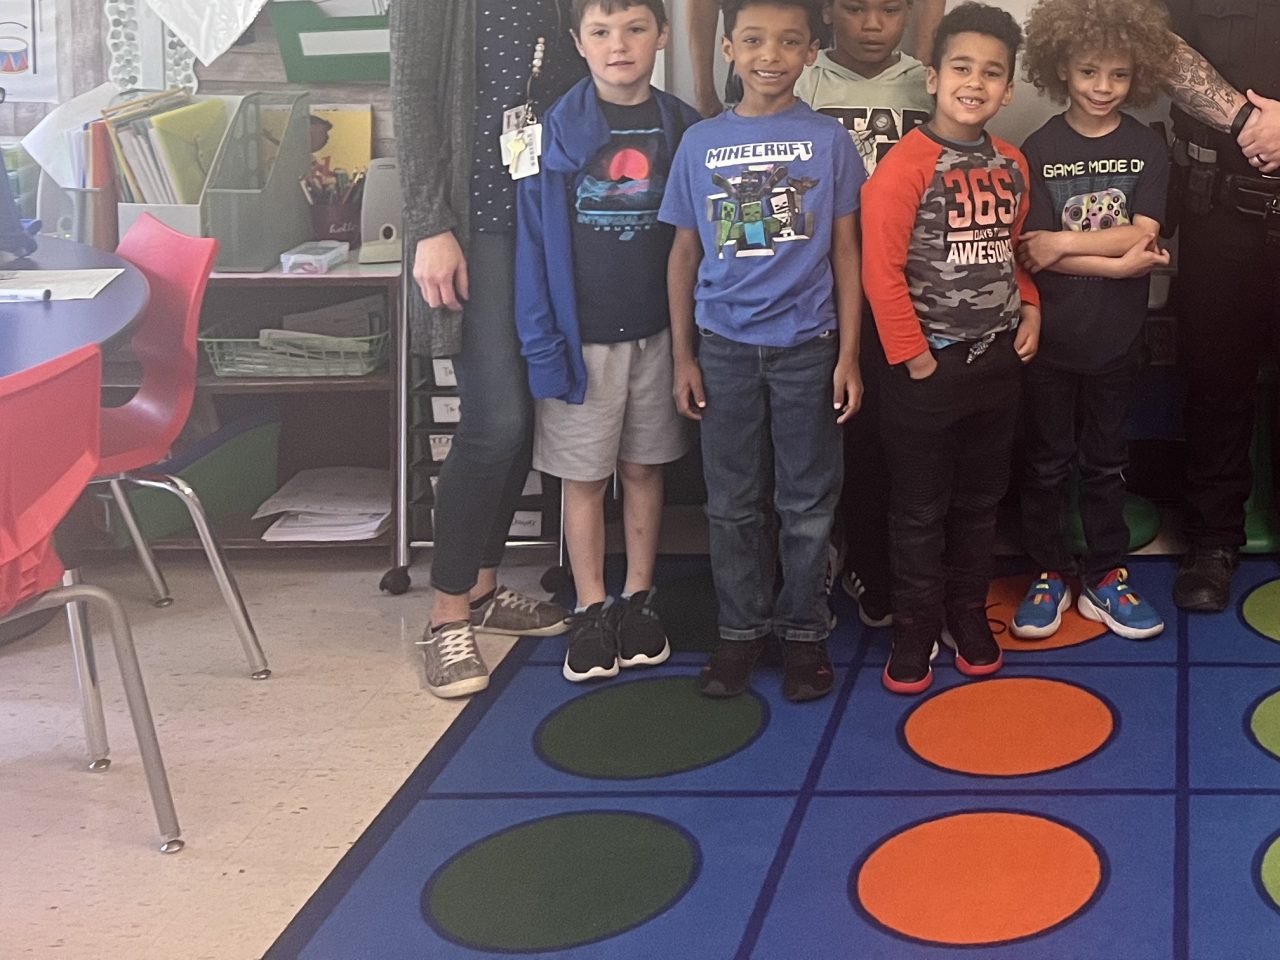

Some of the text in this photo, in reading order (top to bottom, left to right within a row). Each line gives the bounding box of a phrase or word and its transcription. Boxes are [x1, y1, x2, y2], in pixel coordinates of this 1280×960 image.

[705, 141, 812, 169] MINECRAFT
[1043, 161, 1086, 178] GAME
[1088, 159, 1128, 173] MODE
[943, 168, 1016, 229] 365
[974, 228, 994, 241] DAYS
